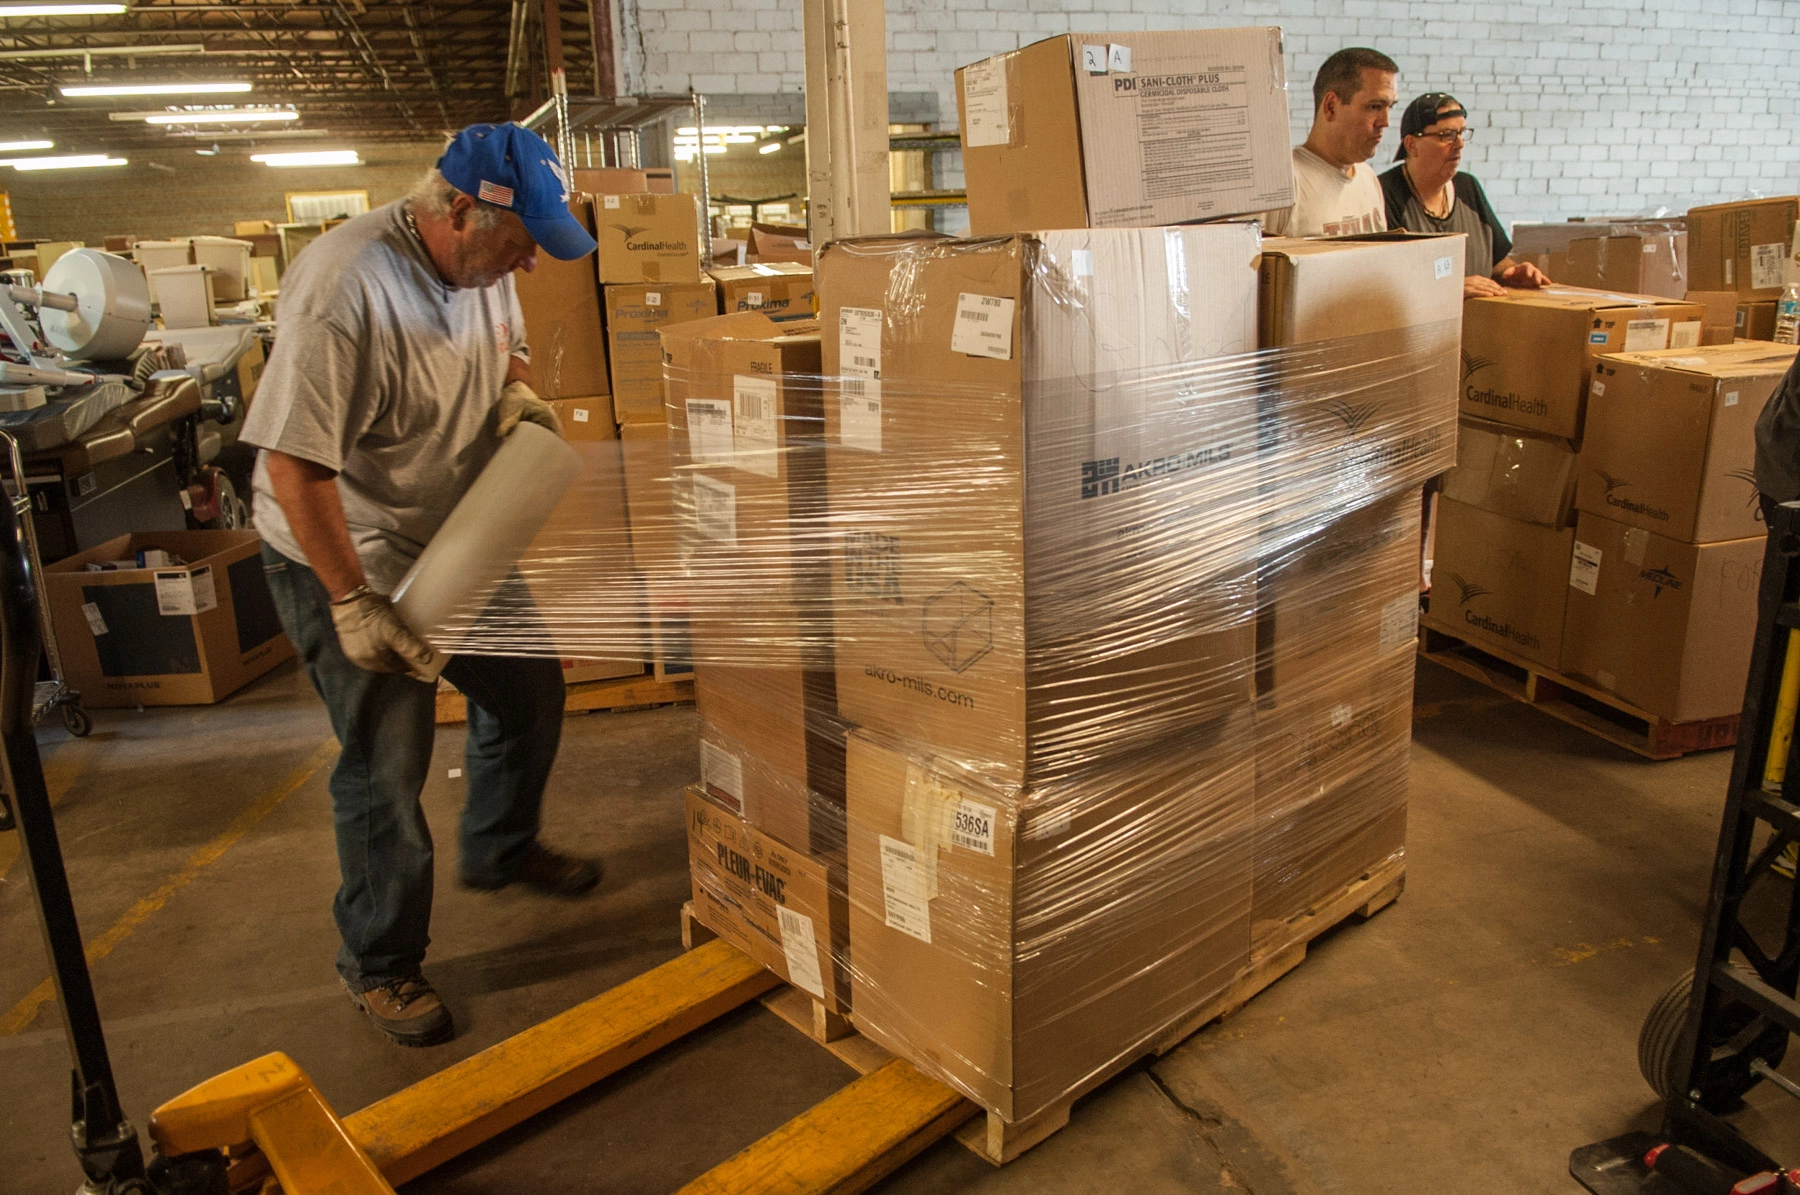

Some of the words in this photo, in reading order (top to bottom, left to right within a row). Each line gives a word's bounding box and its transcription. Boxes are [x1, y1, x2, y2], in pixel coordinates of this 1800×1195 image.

[1086, 51, 1096, 67] 2
[1114, 50, 1122, 64] A
[1114, 78, 1137, 91] PDI
[1141, 74, 1194, 88] SANI-CLOTH
[1198, 74, 1220, 84] PLUS
[1140, 89, 1175, 98] GERMICIDAL
[1176, 86, 1210, 95] DISPOSABLE
[1212, 85, 1229, 93] CLOTH
[626, 241, 687, 251] CardinalHealth
[737, 299, 790, 312] Proxima
[615, 308, 668, 319] Proxima
[750, 361, 773, 374] FRAGILE
[1466, 385, 1548, 416] CardinalHealth
[1606, 494, 1669, 522] CardinalHealth
[1465, 609, 1540, 651] CardinalHealth
[864, 664, 975, 709] akro-mils.com
[955, 811, 989, 838] 536SA
[716, 841, 787, 905] PLEUR-EVAC
